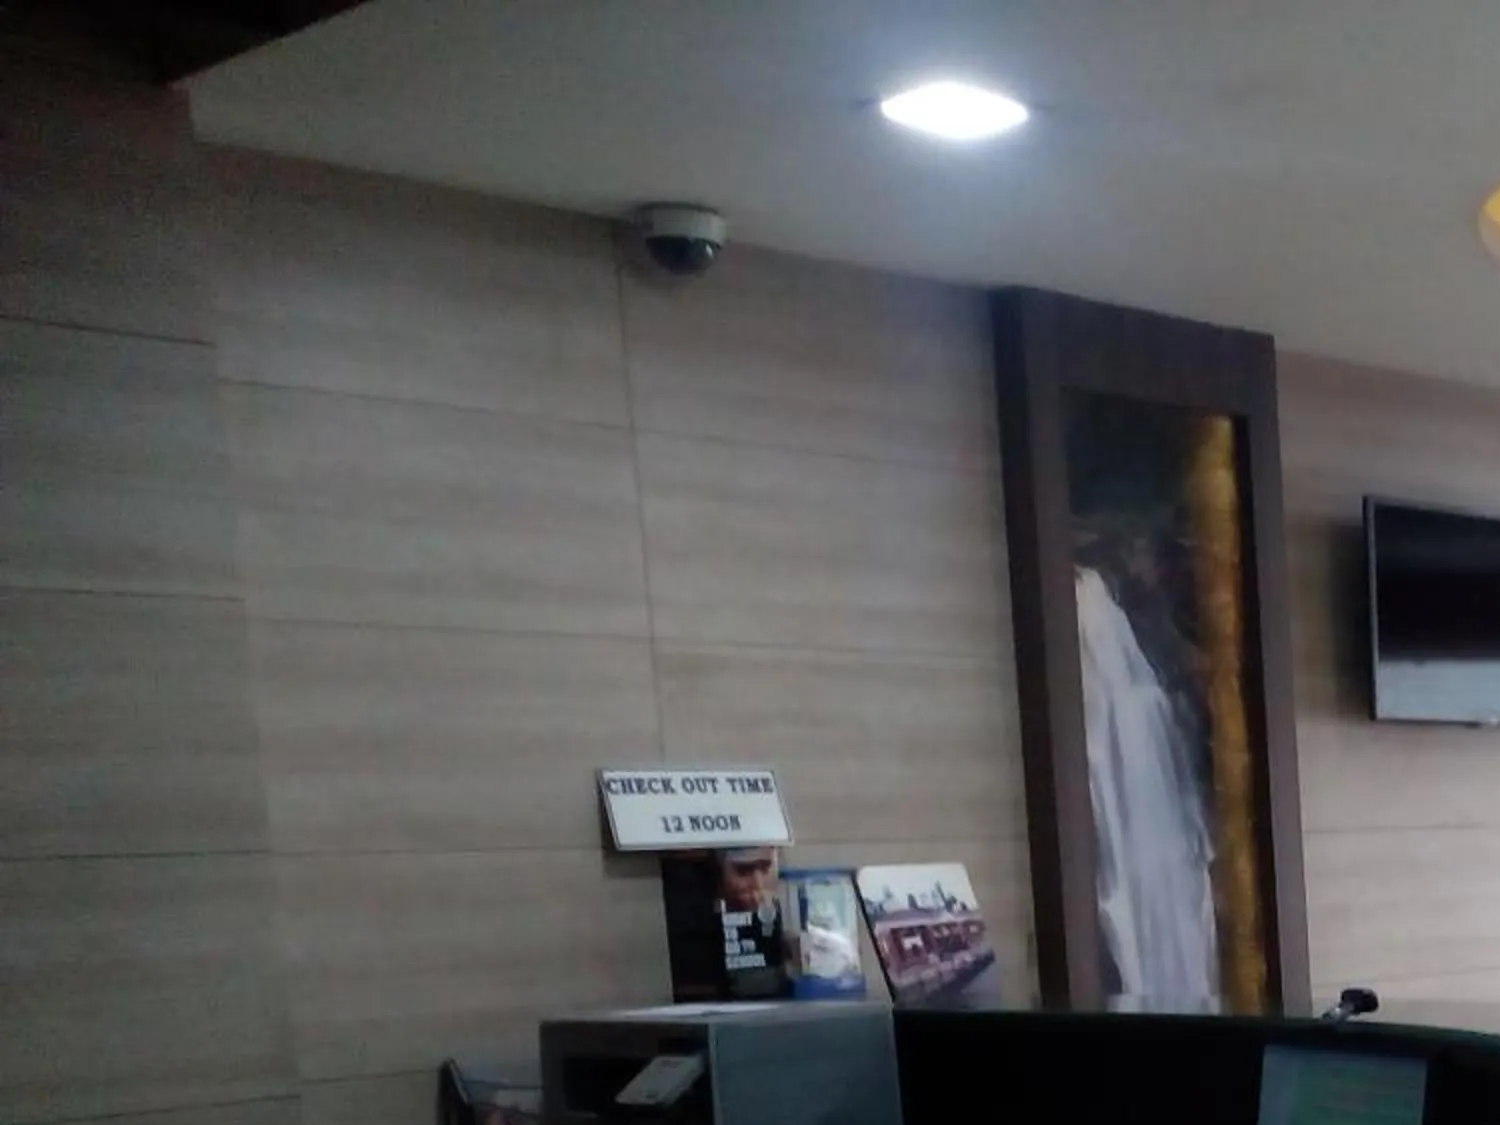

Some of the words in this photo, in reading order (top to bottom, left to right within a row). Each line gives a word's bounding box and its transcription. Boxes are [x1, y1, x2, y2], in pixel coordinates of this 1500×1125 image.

[606, 777, 677, 795] CHECK
[681, 777, 719, 794] OUT
[725, 777, 774, 794] TIME
[660, 815, 686, 833] 12
[688, 814, 742, 832] NOON
